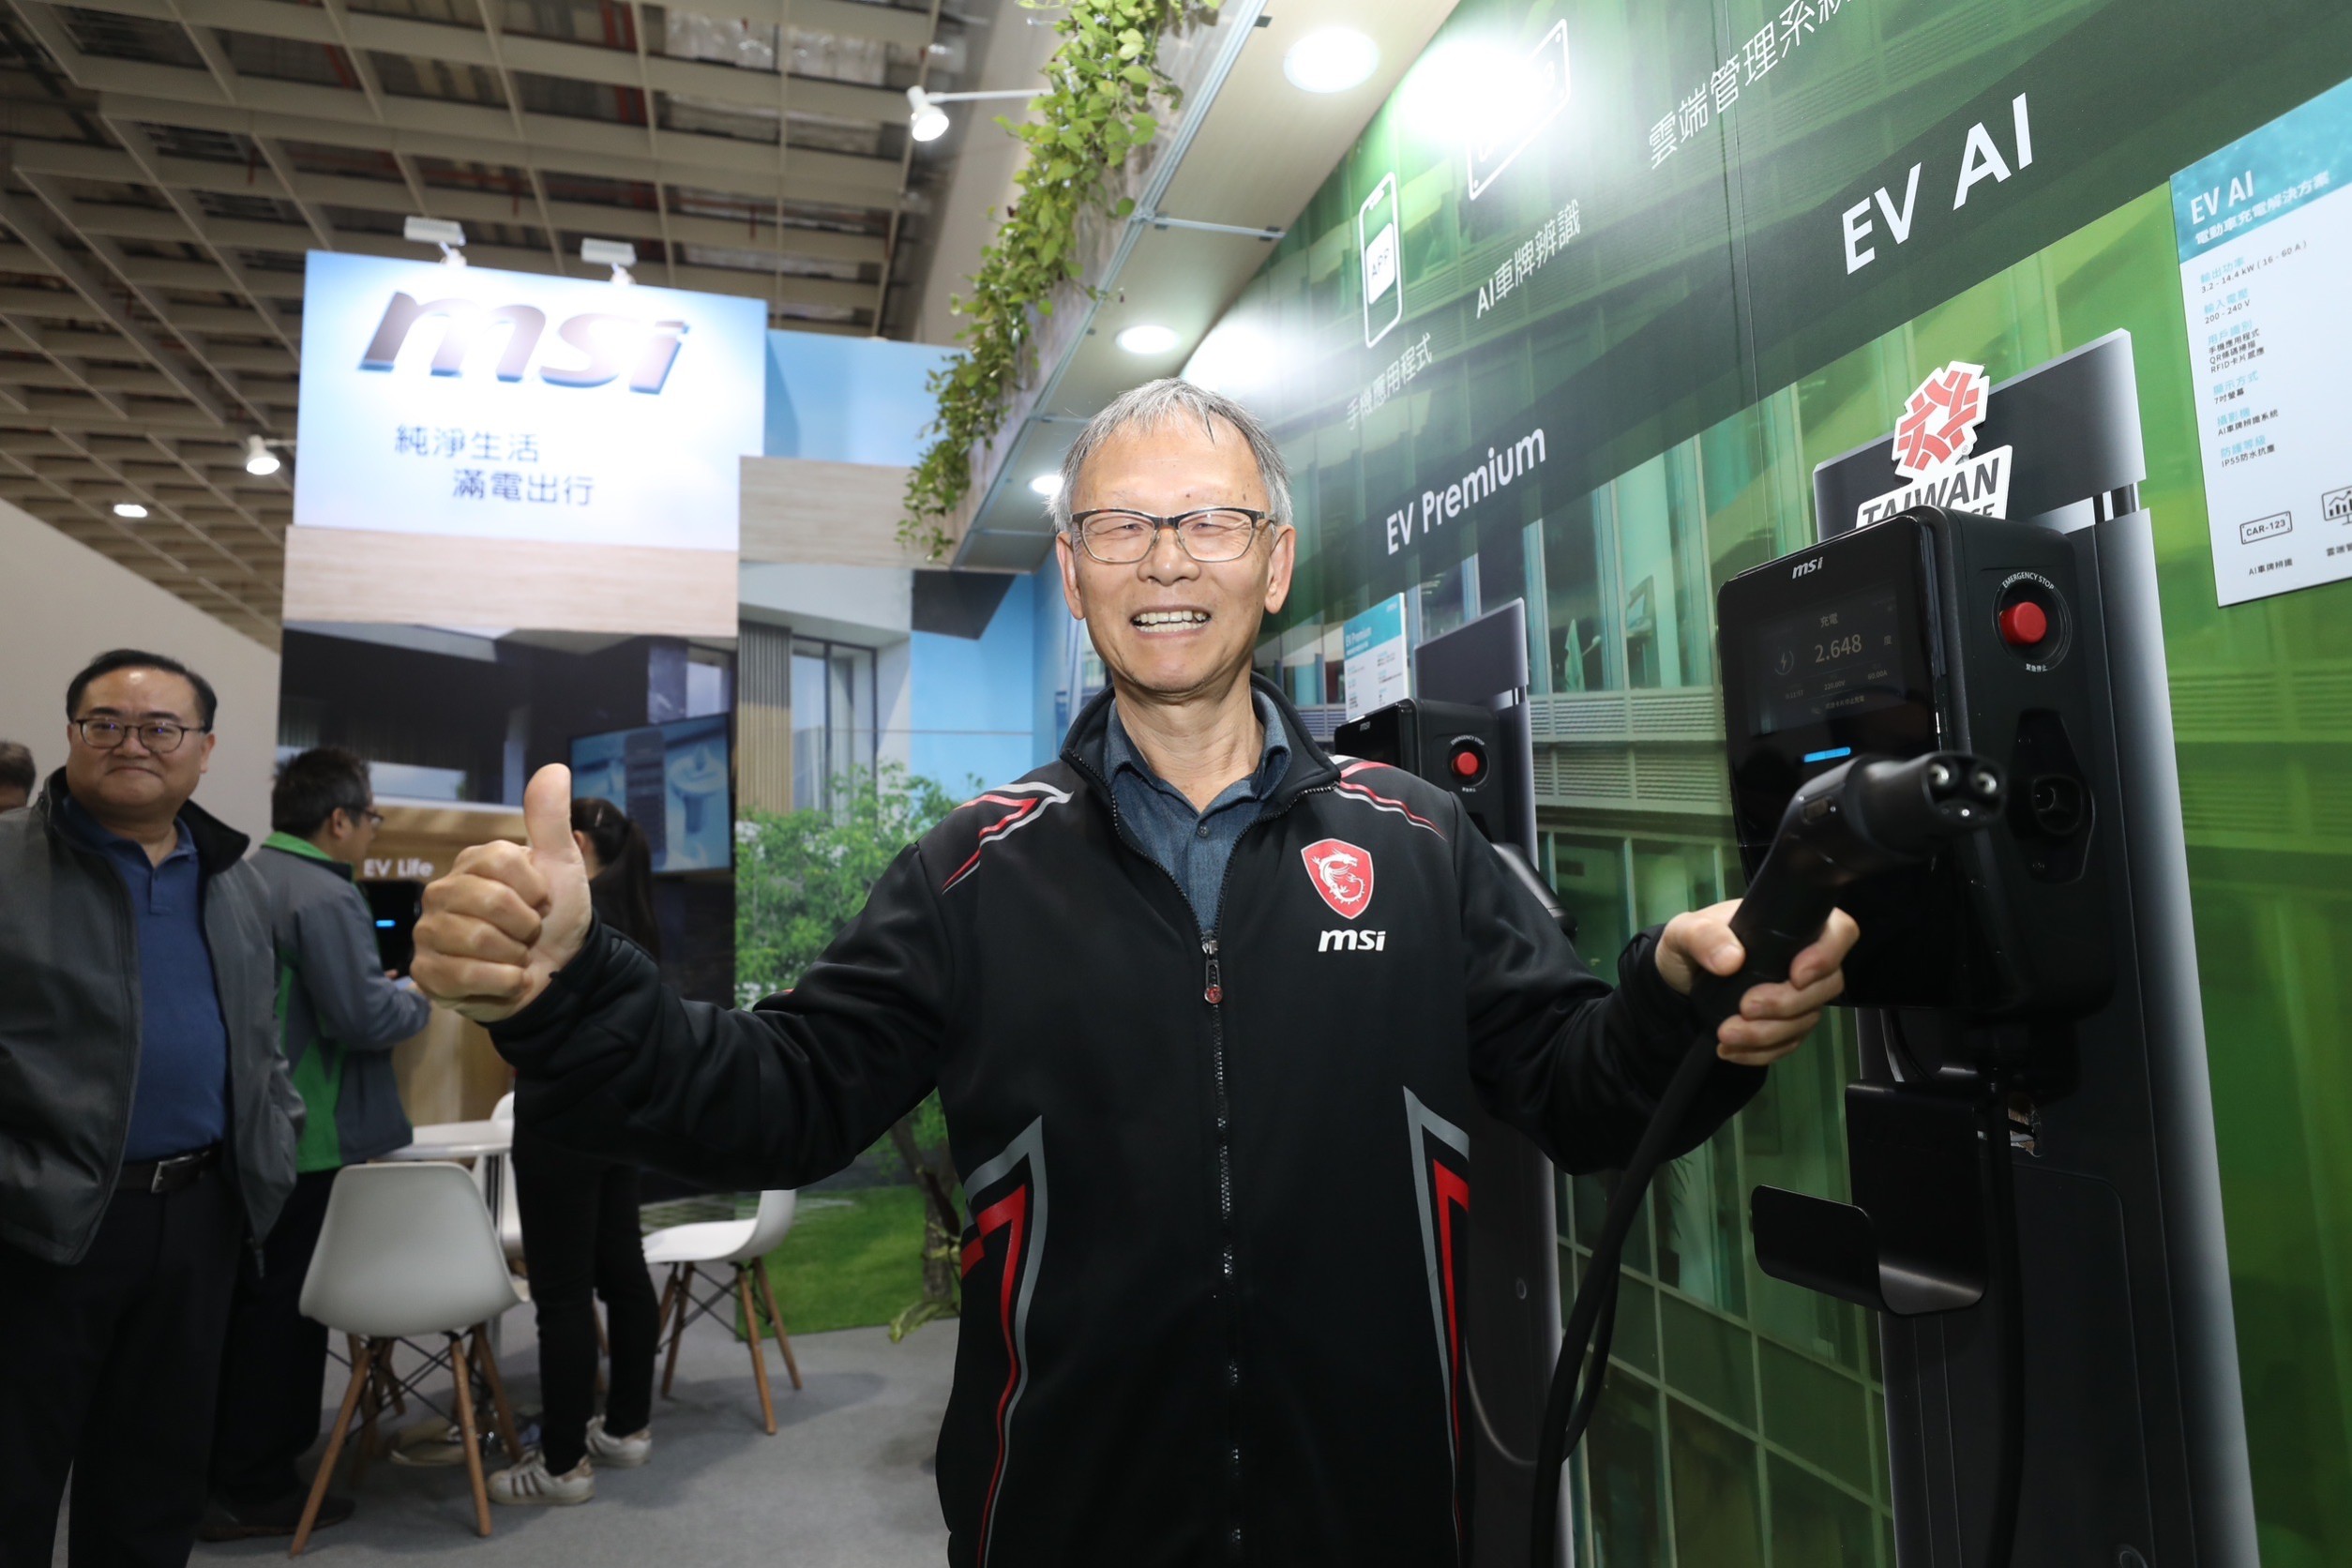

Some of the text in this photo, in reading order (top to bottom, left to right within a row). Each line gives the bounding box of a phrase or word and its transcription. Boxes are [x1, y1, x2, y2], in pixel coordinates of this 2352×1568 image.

[1842, 92, 2032, 276] EV AI
[2190, 170, 2254, 225] EV AI
[2195, 170, 2329, 245] 電動車充電解決方案
[1370, 248, 1390, 279] APP
[1477, 198, 1580, 319] AI車牌辨識
[2201, 282, 2214, 294] 3.2
[2222, 272, 2239, 285] 14.4
[2241, 264, 2255, 276] kW
[2205, 312, 2220, 324] 200
[2227, 303, 2242, 315] 240
[2244, 299, 2251, 308] V
[357, 291, 689, 395] msi
[1346, 332, 1433, 431] 手機應用程式
[395, 424, 540, 463] 純淨生活
[452, 468, 595, 507] 滿電出行
[1386, 428, 1546, 556] EV Premium
[2246, 519, 2286, 536] CAR-123
[1791, 556, 1823, 580] msi
[2001, 571, 2055, 590] EMERGENCY STOP
[1820, 612, 1839, 628] 充電
[1814, 633, 1862, 663] 2.648
[363, 857, 435, 878] EV Life
[1317, 929, 1386, 953] msi
